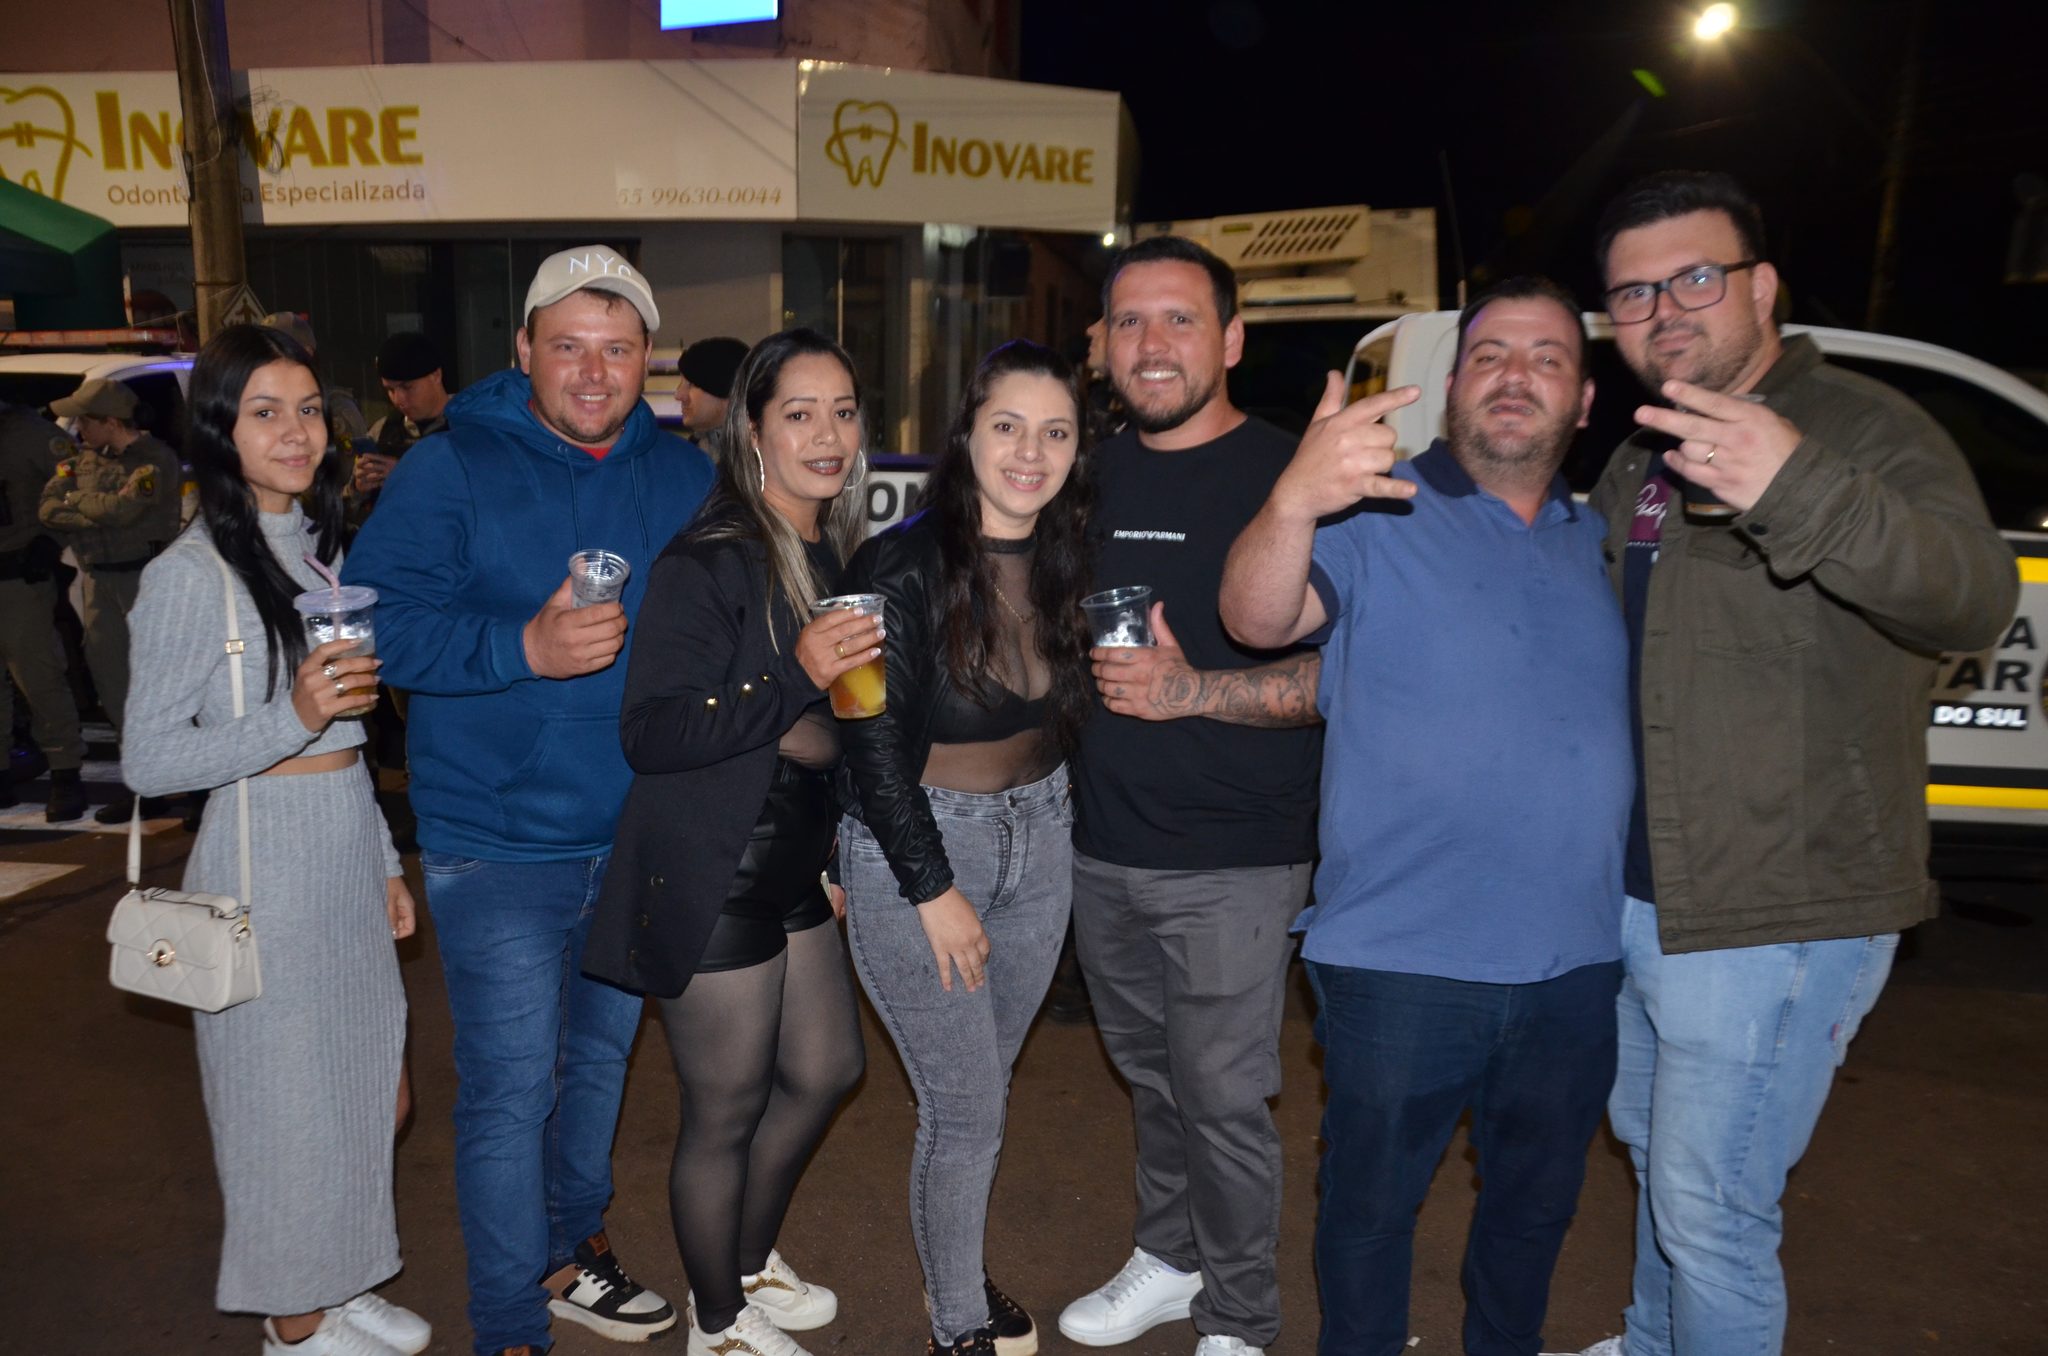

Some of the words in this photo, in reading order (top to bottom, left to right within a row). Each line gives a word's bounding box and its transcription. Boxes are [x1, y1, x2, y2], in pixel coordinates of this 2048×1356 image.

[95, 89, 424, 171] INVARE
[913, 121, 1095, 184] INOVARE
[107, 183, 254, 205] Odonta
[261, 180, 425, 207] Especializada
[618, 187, 644, 206] 55
[652, 185, 782, 208] 99630-0044
[1113, 529, 1147, 540] EMPORIO
[1154, 531, 1186, 541] ARMANI
[2000, 616, 2036, 649] A
[1933, 705, 1973, 725] DO
[1975, 707, 2027, 727] SUL
